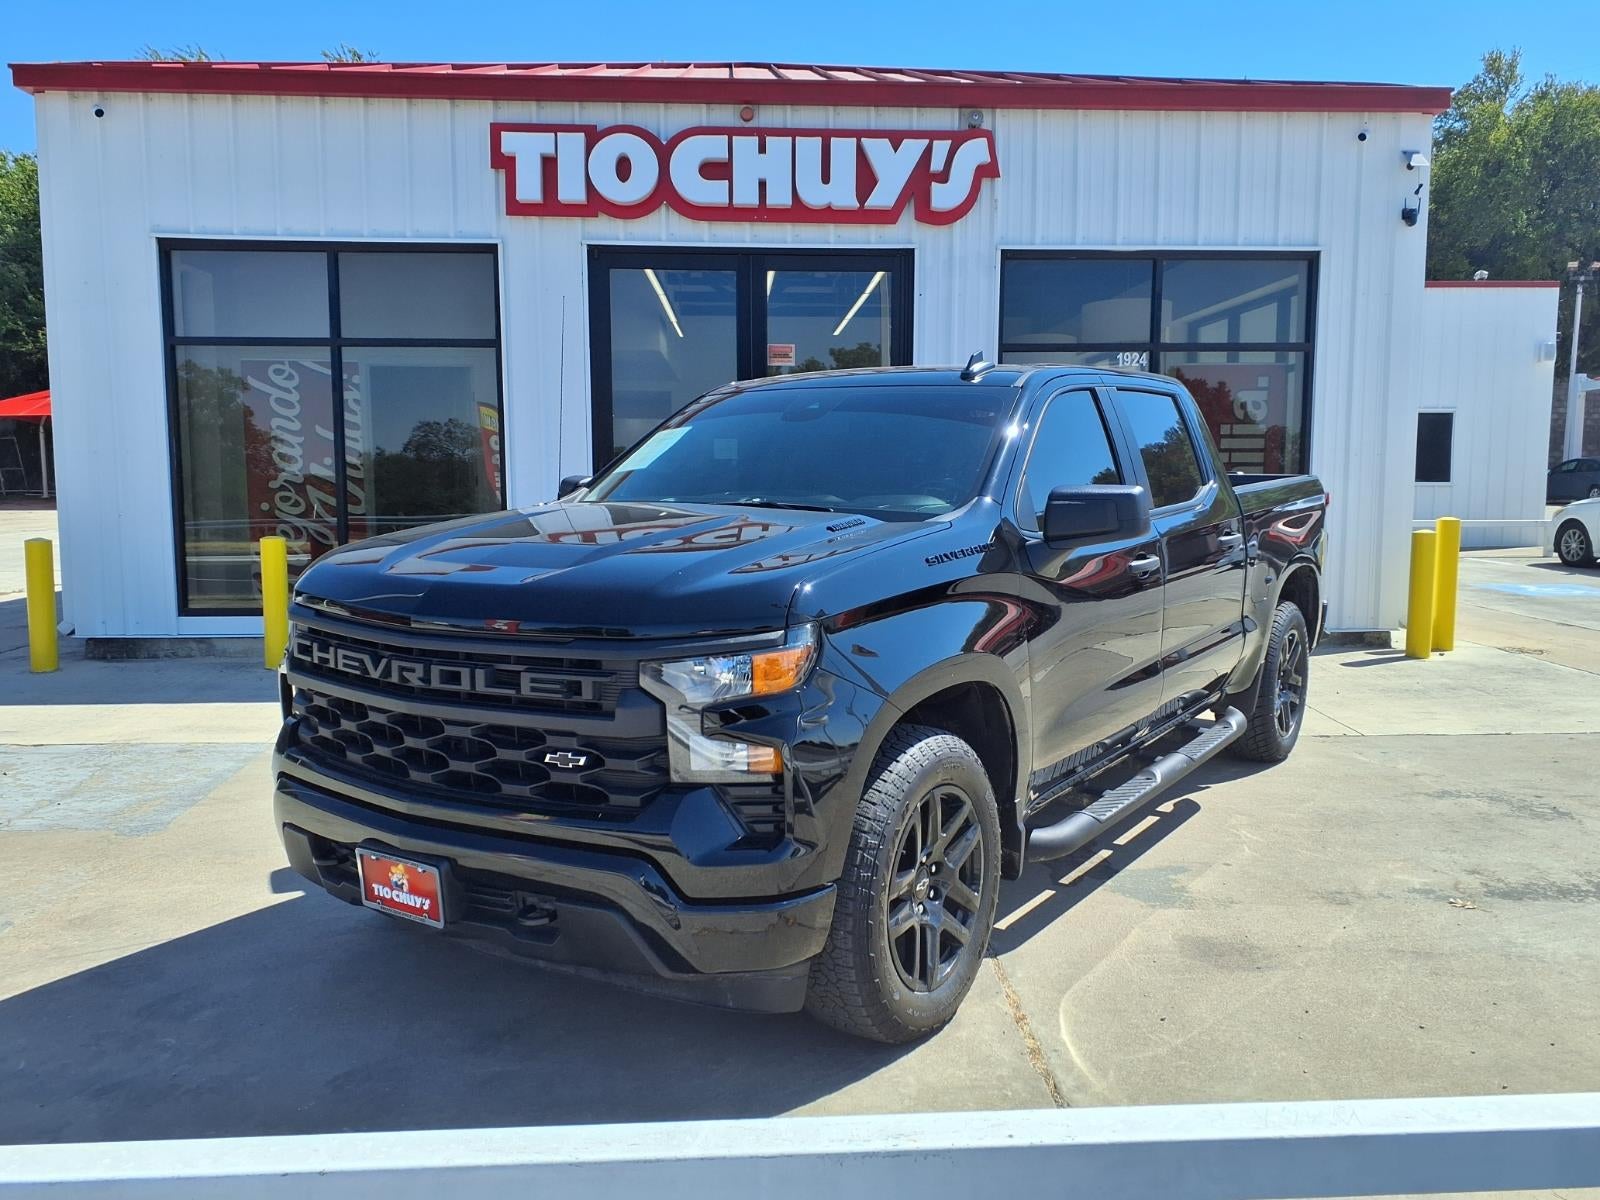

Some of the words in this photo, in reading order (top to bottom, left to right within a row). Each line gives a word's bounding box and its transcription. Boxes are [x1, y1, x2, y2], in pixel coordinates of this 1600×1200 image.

[1116, 352, 1148, 367] 1924
[247, 361, 335, 587] ejorando
[293, 637, 614, 700] CHEVROLET
